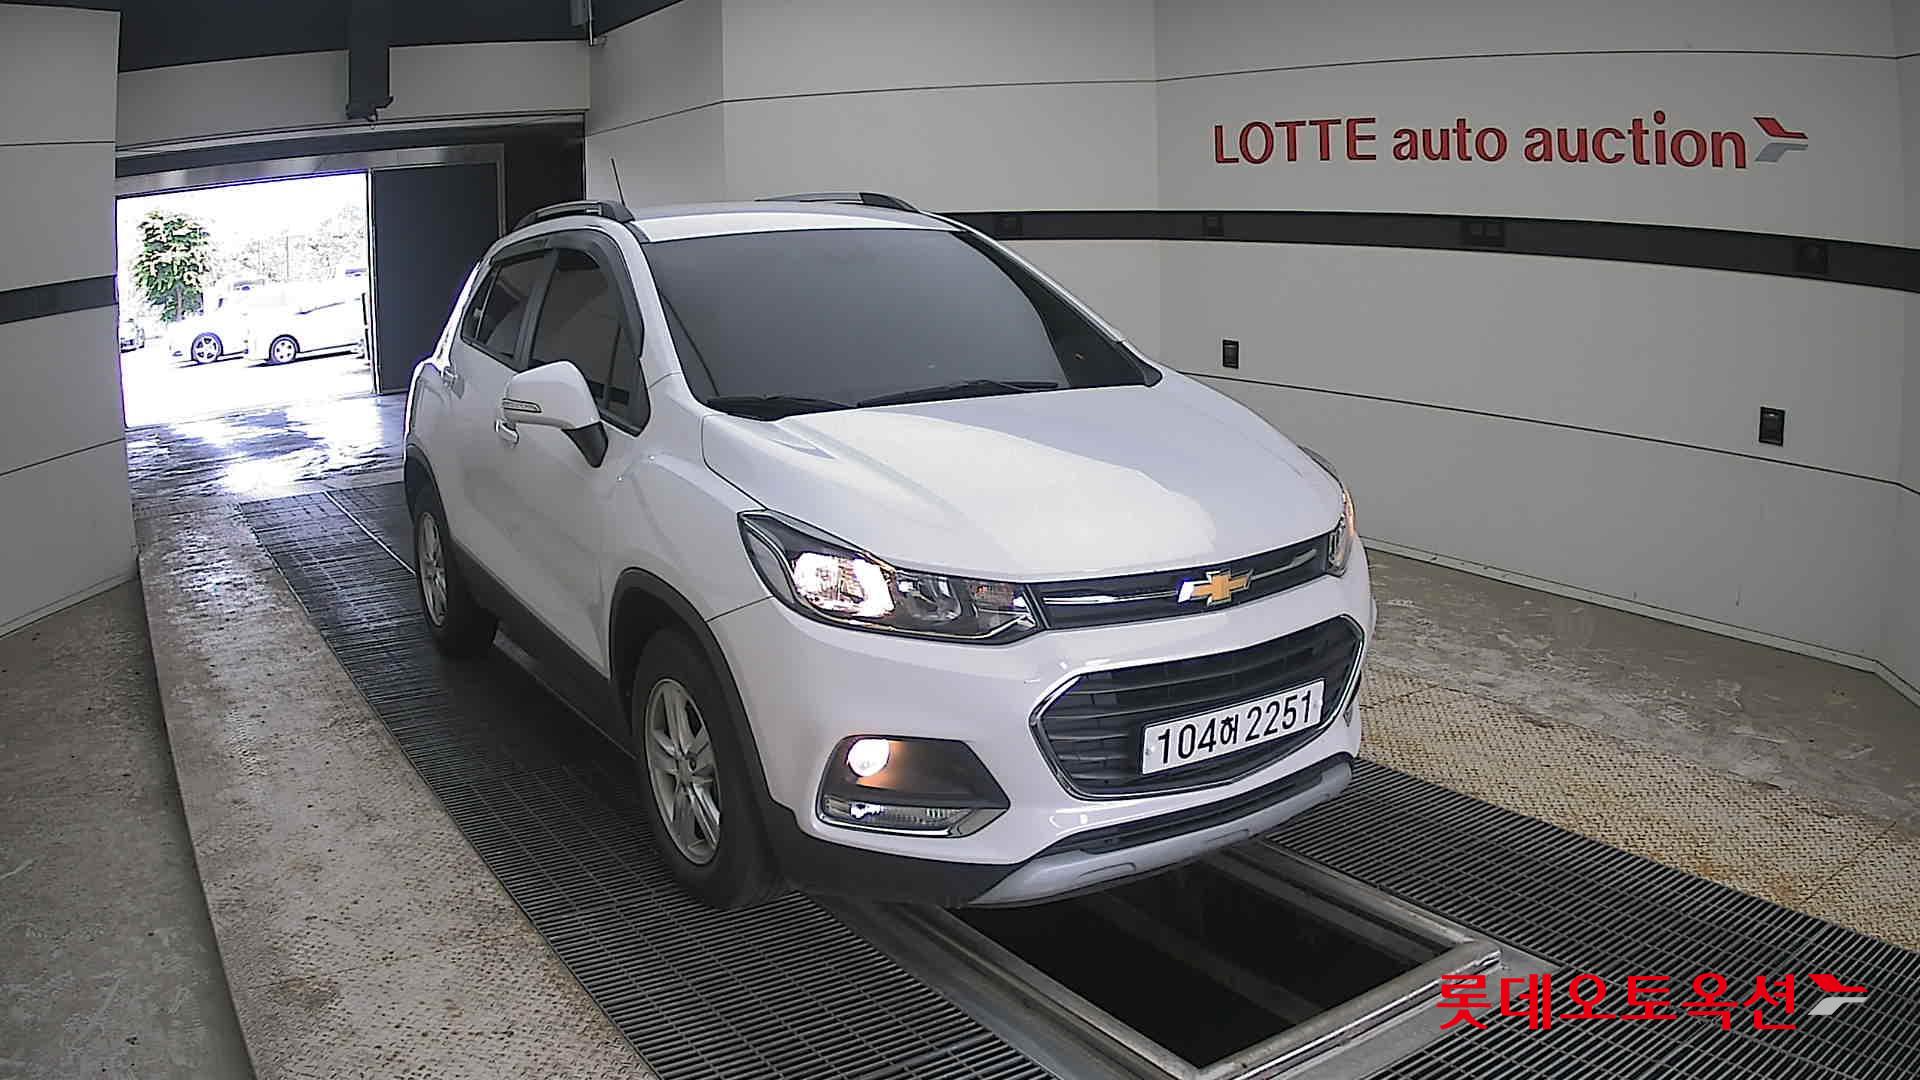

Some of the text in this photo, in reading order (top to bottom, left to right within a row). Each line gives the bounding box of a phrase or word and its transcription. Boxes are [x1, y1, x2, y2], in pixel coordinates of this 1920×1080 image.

[1213, 110, 1747, 169] LOTTE auto auction
[1157, 690, 1312, 764] 104허 2251
